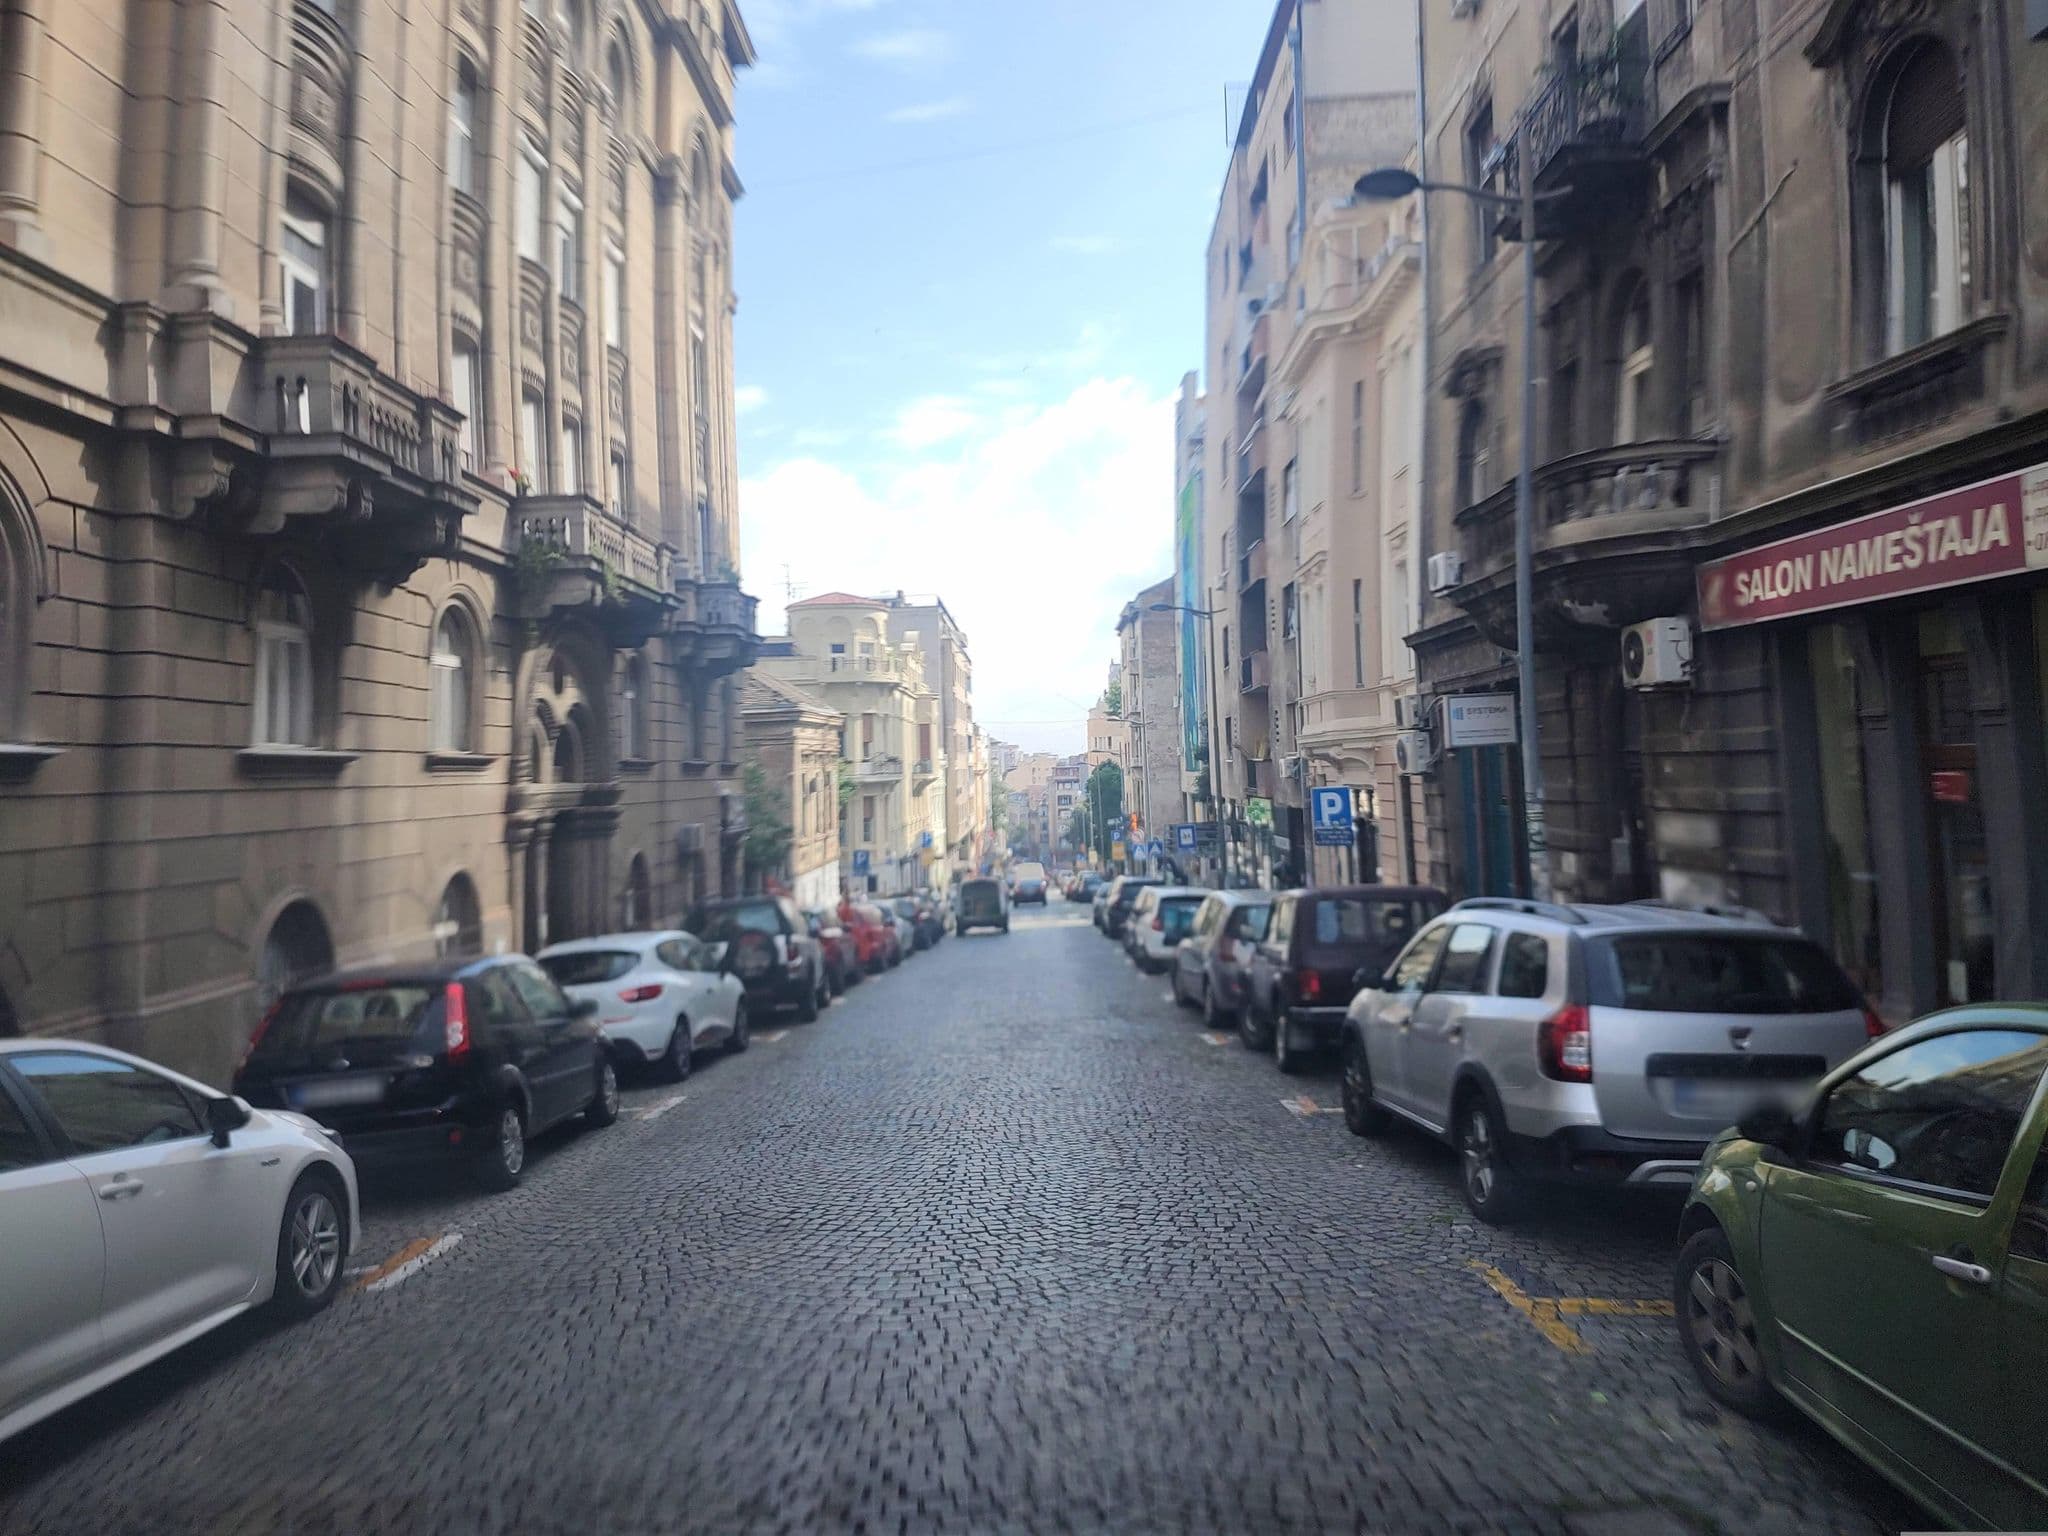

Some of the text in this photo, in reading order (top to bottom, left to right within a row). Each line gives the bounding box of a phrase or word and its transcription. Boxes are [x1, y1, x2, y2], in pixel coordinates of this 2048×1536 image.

[1735, 503, 2011, 606] SALON NAMEŠTAJA
[1320, 792, 1343, 826] P
